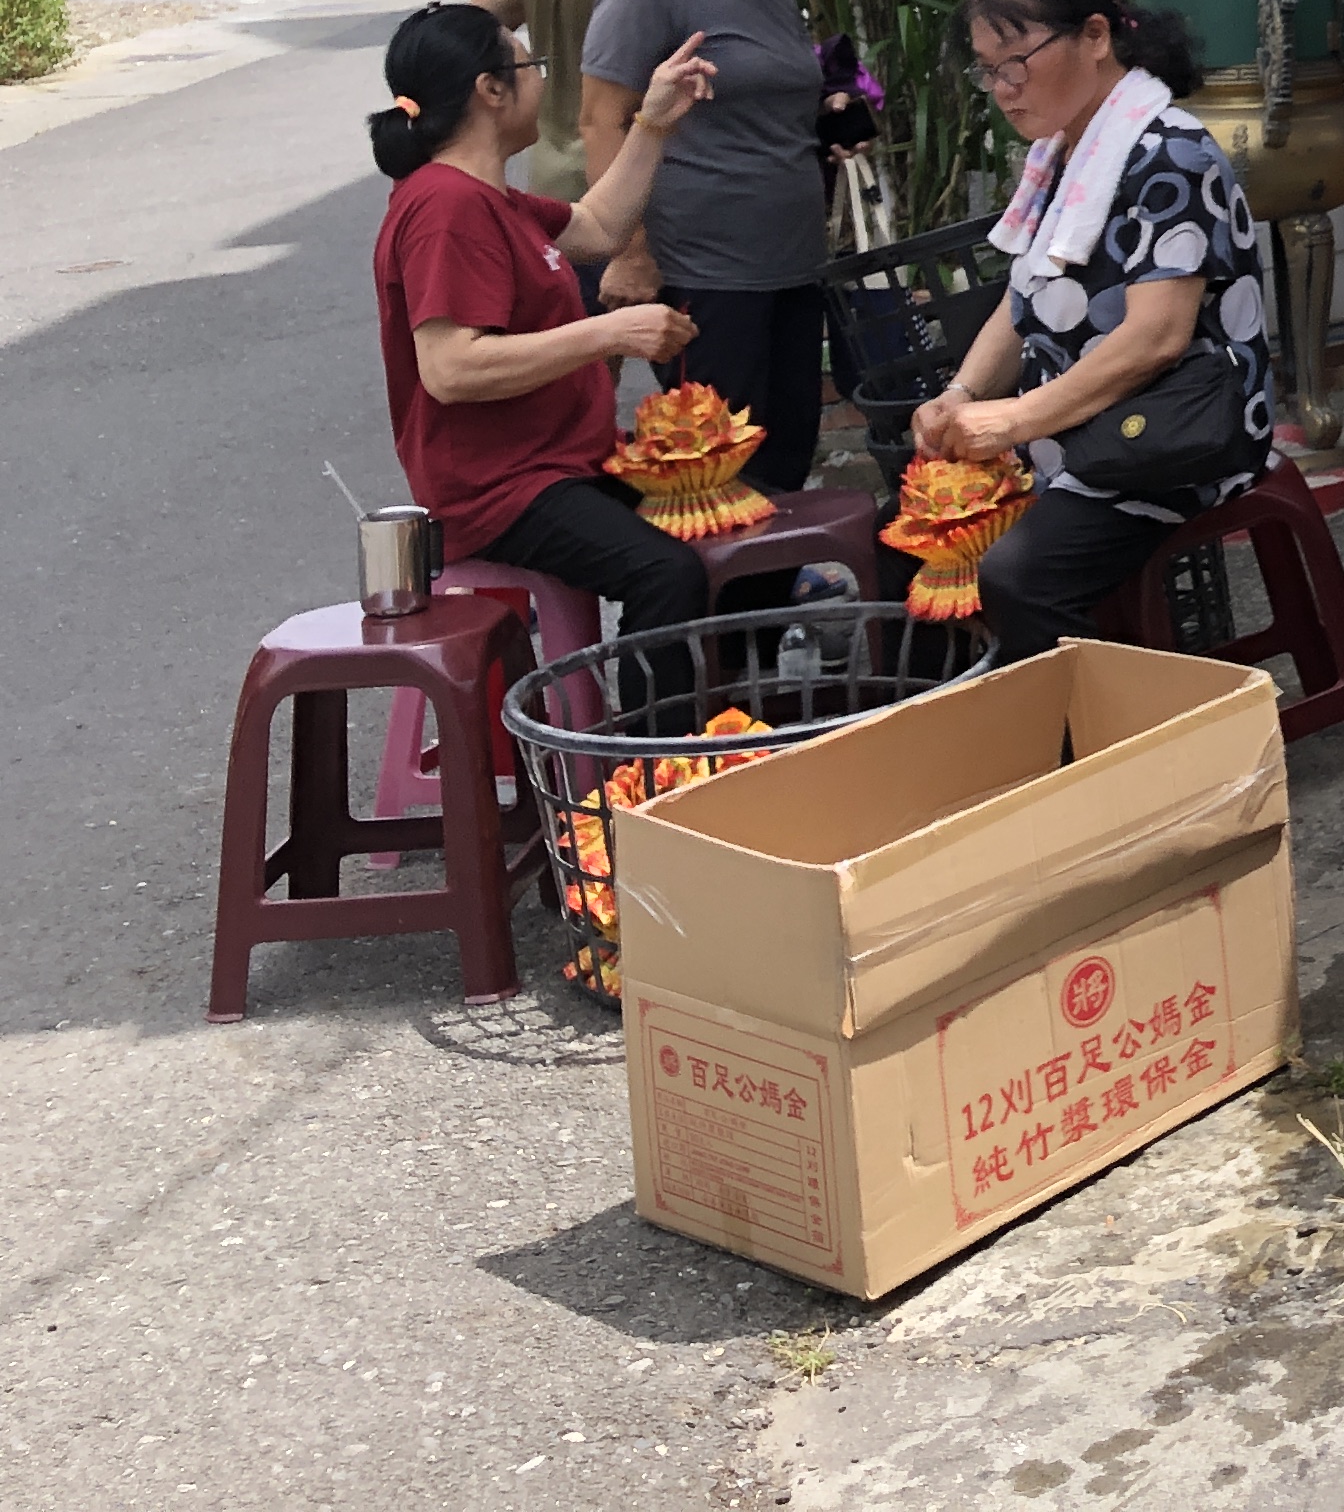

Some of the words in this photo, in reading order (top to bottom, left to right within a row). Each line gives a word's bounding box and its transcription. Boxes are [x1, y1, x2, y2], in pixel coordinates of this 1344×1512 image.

[686, 1055, 808, 1122] 百足公媽金
